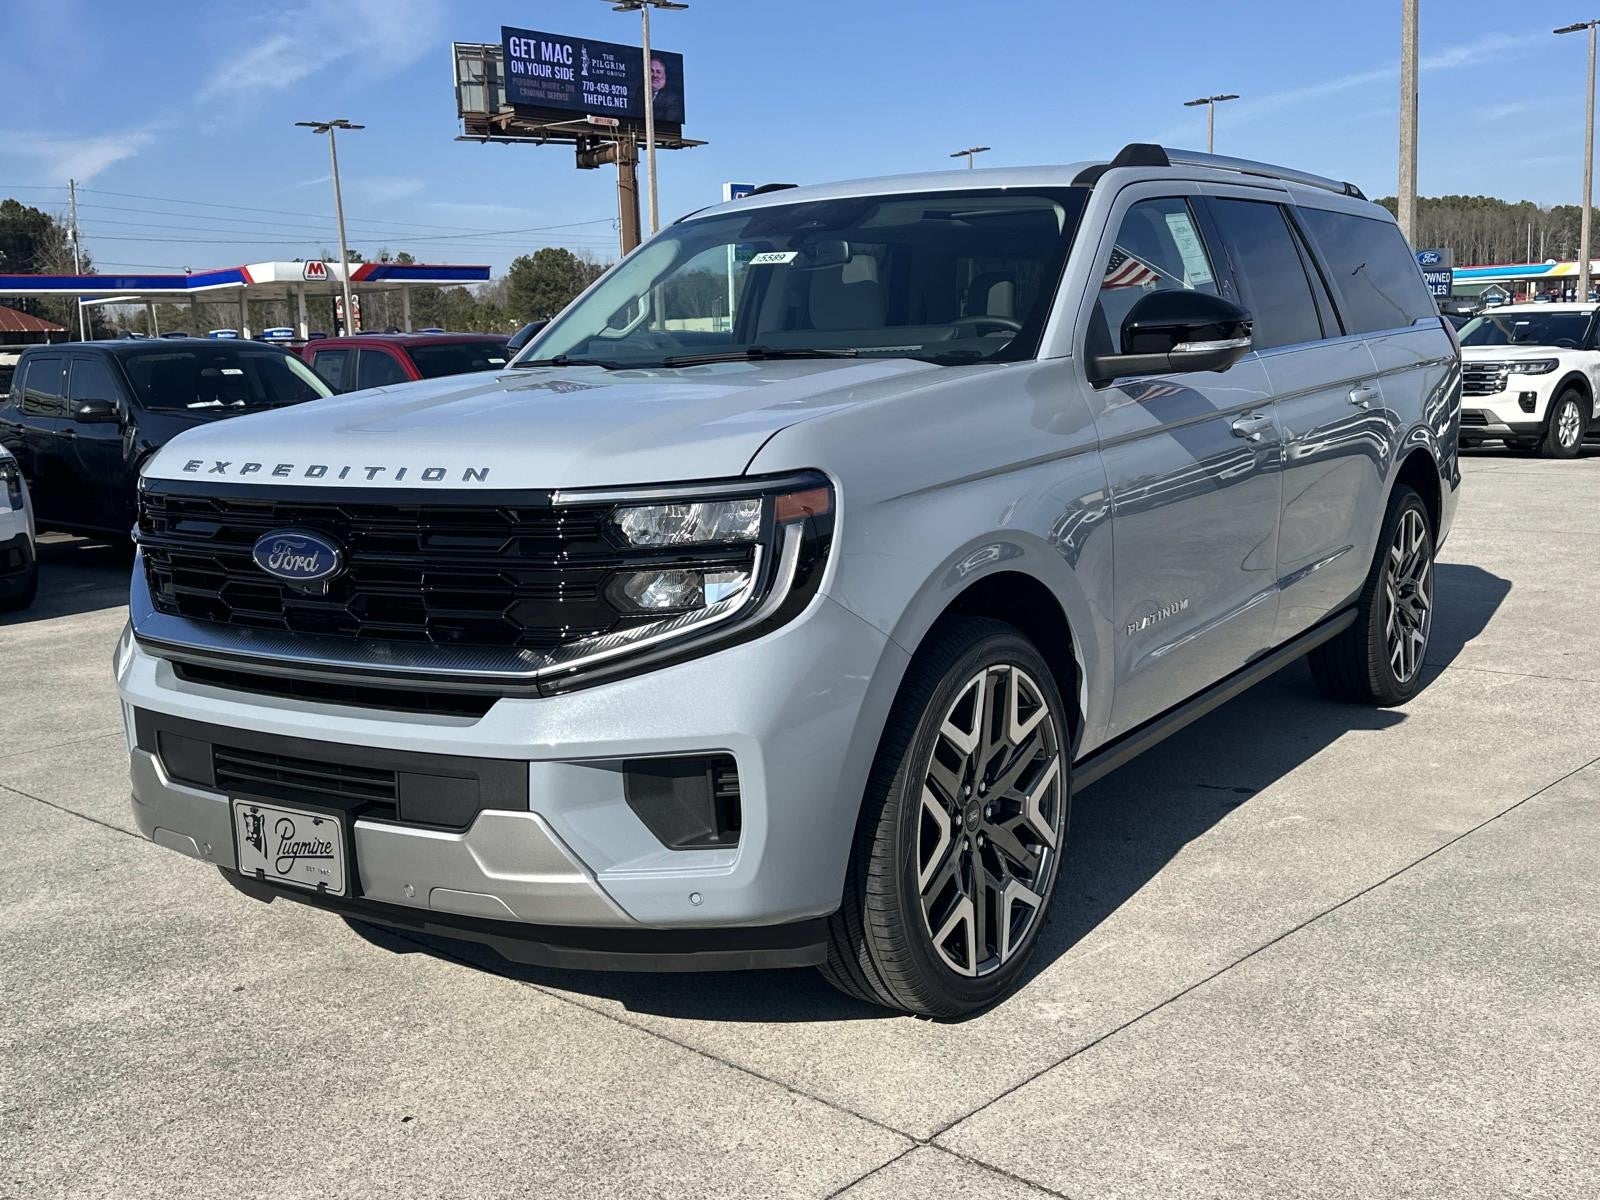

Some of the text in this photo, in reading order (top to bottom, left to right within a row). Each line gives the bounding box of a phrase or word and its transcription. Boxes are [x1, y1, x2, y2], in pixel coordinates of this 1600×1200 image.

[509, 36, 573, 65] GET MAC
[602, 53, 615, 61] THE
[511, 60, 575, 81] ON YOUR SIDE
[591, 58, 626, 71] PILGRIM
[582, 80, 628, 96] 770-459-9210
[583, 92, 628, 109] THEPLG.NET
[307, 262, 325, 275] M
[182, 459, 490, 483] EXPEDITION
[268, 539, 320, 574] Ford
[1127, 599, 1189, 636] PLATINUM
[275, 817, 335, 875] Pugmire
